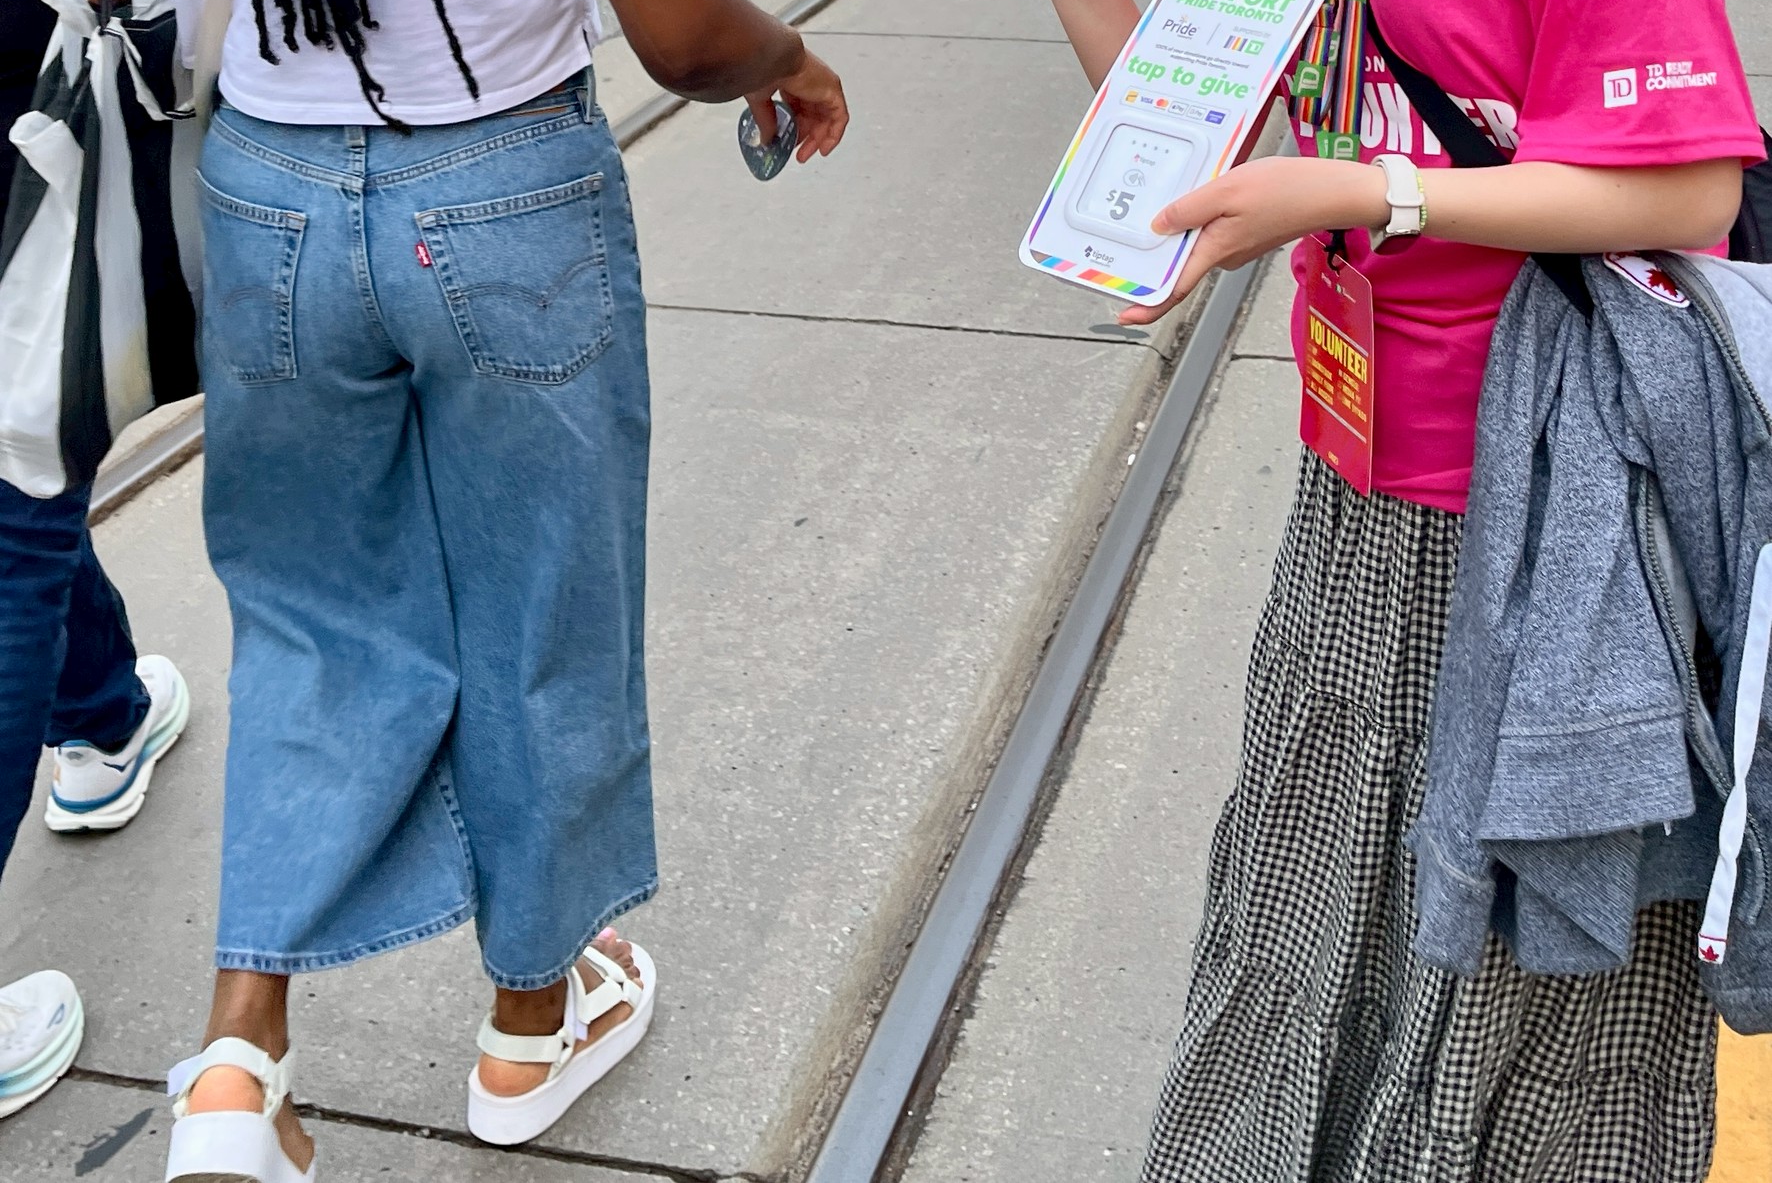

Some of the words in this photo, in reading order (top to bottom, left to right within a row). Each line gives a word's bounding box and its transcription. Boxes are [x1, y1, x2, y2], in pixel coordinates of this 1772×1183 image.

[1219, 0, 1284, 24] TORONTO
[1162, 19, 1197, 36] Pride
[1128, 55, 1166, 82] tap
[1171, 66, 1195, 86] to
[1196, 73, 1249, 99] give
[1645, 71, 1718, 91] COMMITMENT
[1646, 63, 1663, 77] TD
[1105, 188, 1136, 220] $5
[1092, 248, 1115, 264] tiptap
[1310, 316, 1367, 384] VOLUNTEER
